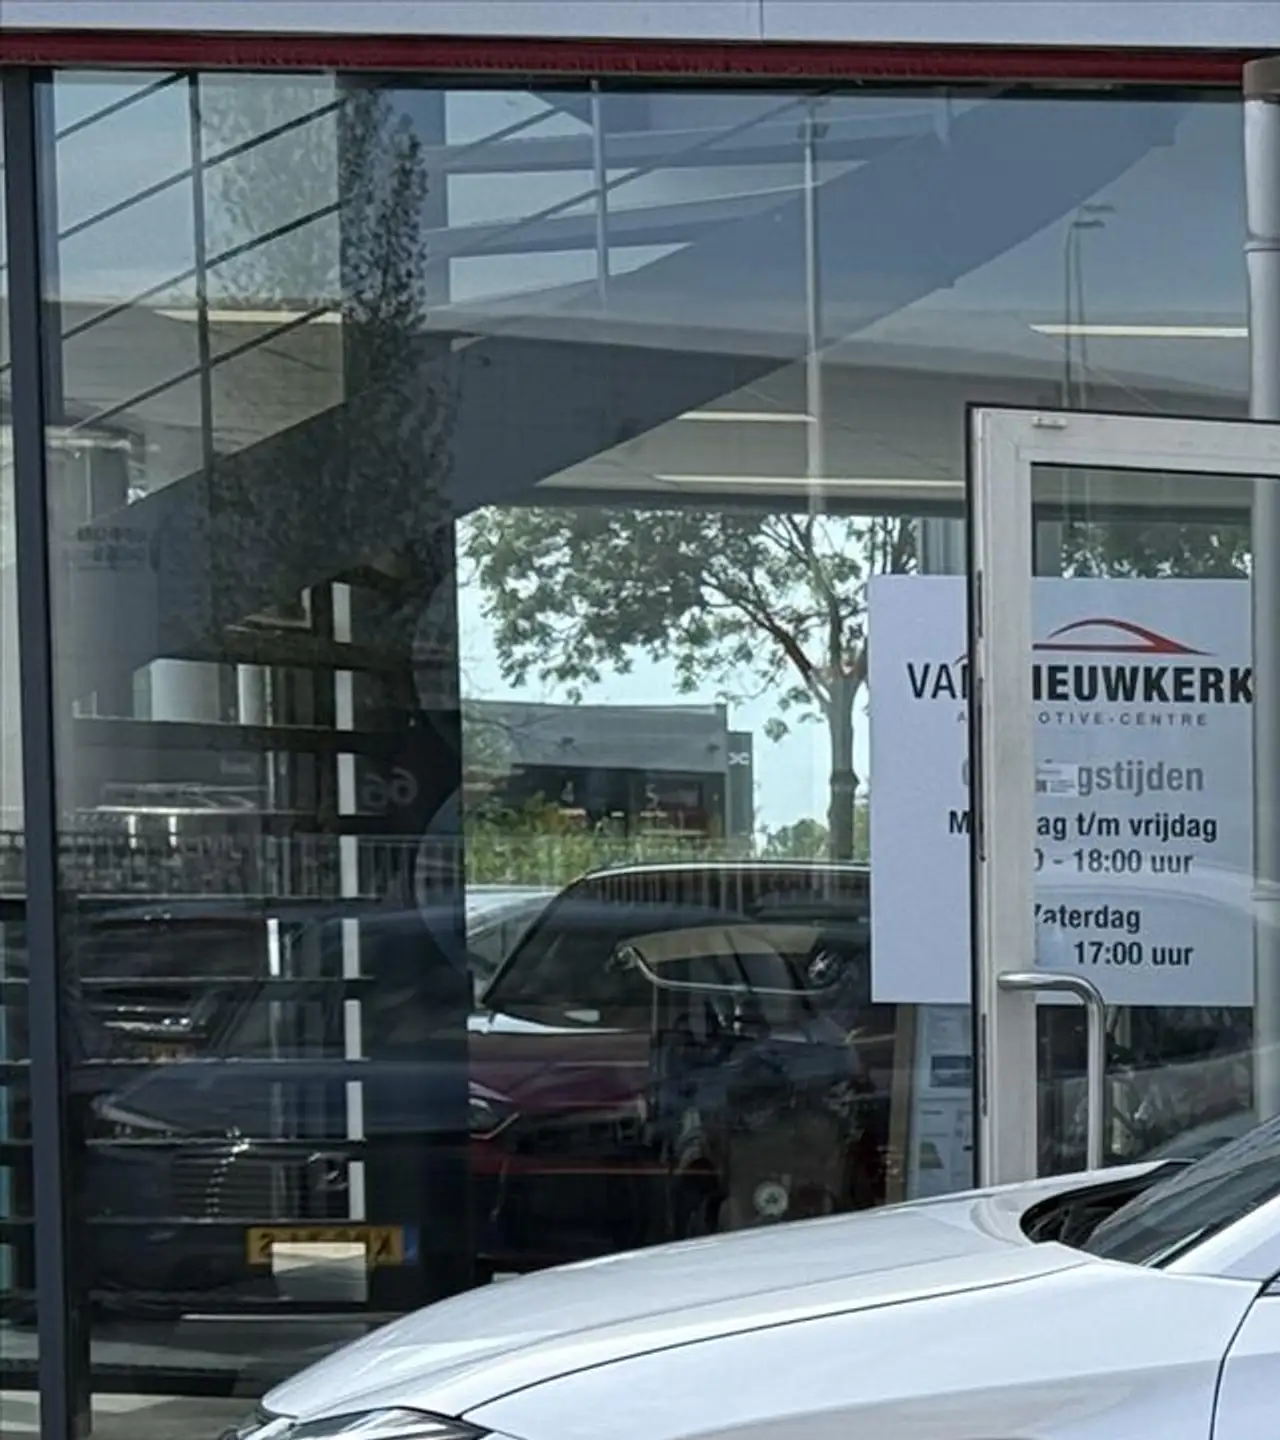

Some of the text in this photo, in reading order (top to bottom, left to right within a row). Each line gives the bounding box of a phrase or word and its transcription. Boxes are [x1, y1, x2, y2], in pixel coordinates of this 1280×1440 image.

[906, 661, 1253, 704] VA IEUWKERK
[1075, 810, 1121, 838] t/m
[1127, 811, 1218, 843] vrijdag
[1072, 847, 1142, 874] 18:00
[1150, 854, 1194, 874] uur
[1074, 940, 1195, 967] 17:00 uur
